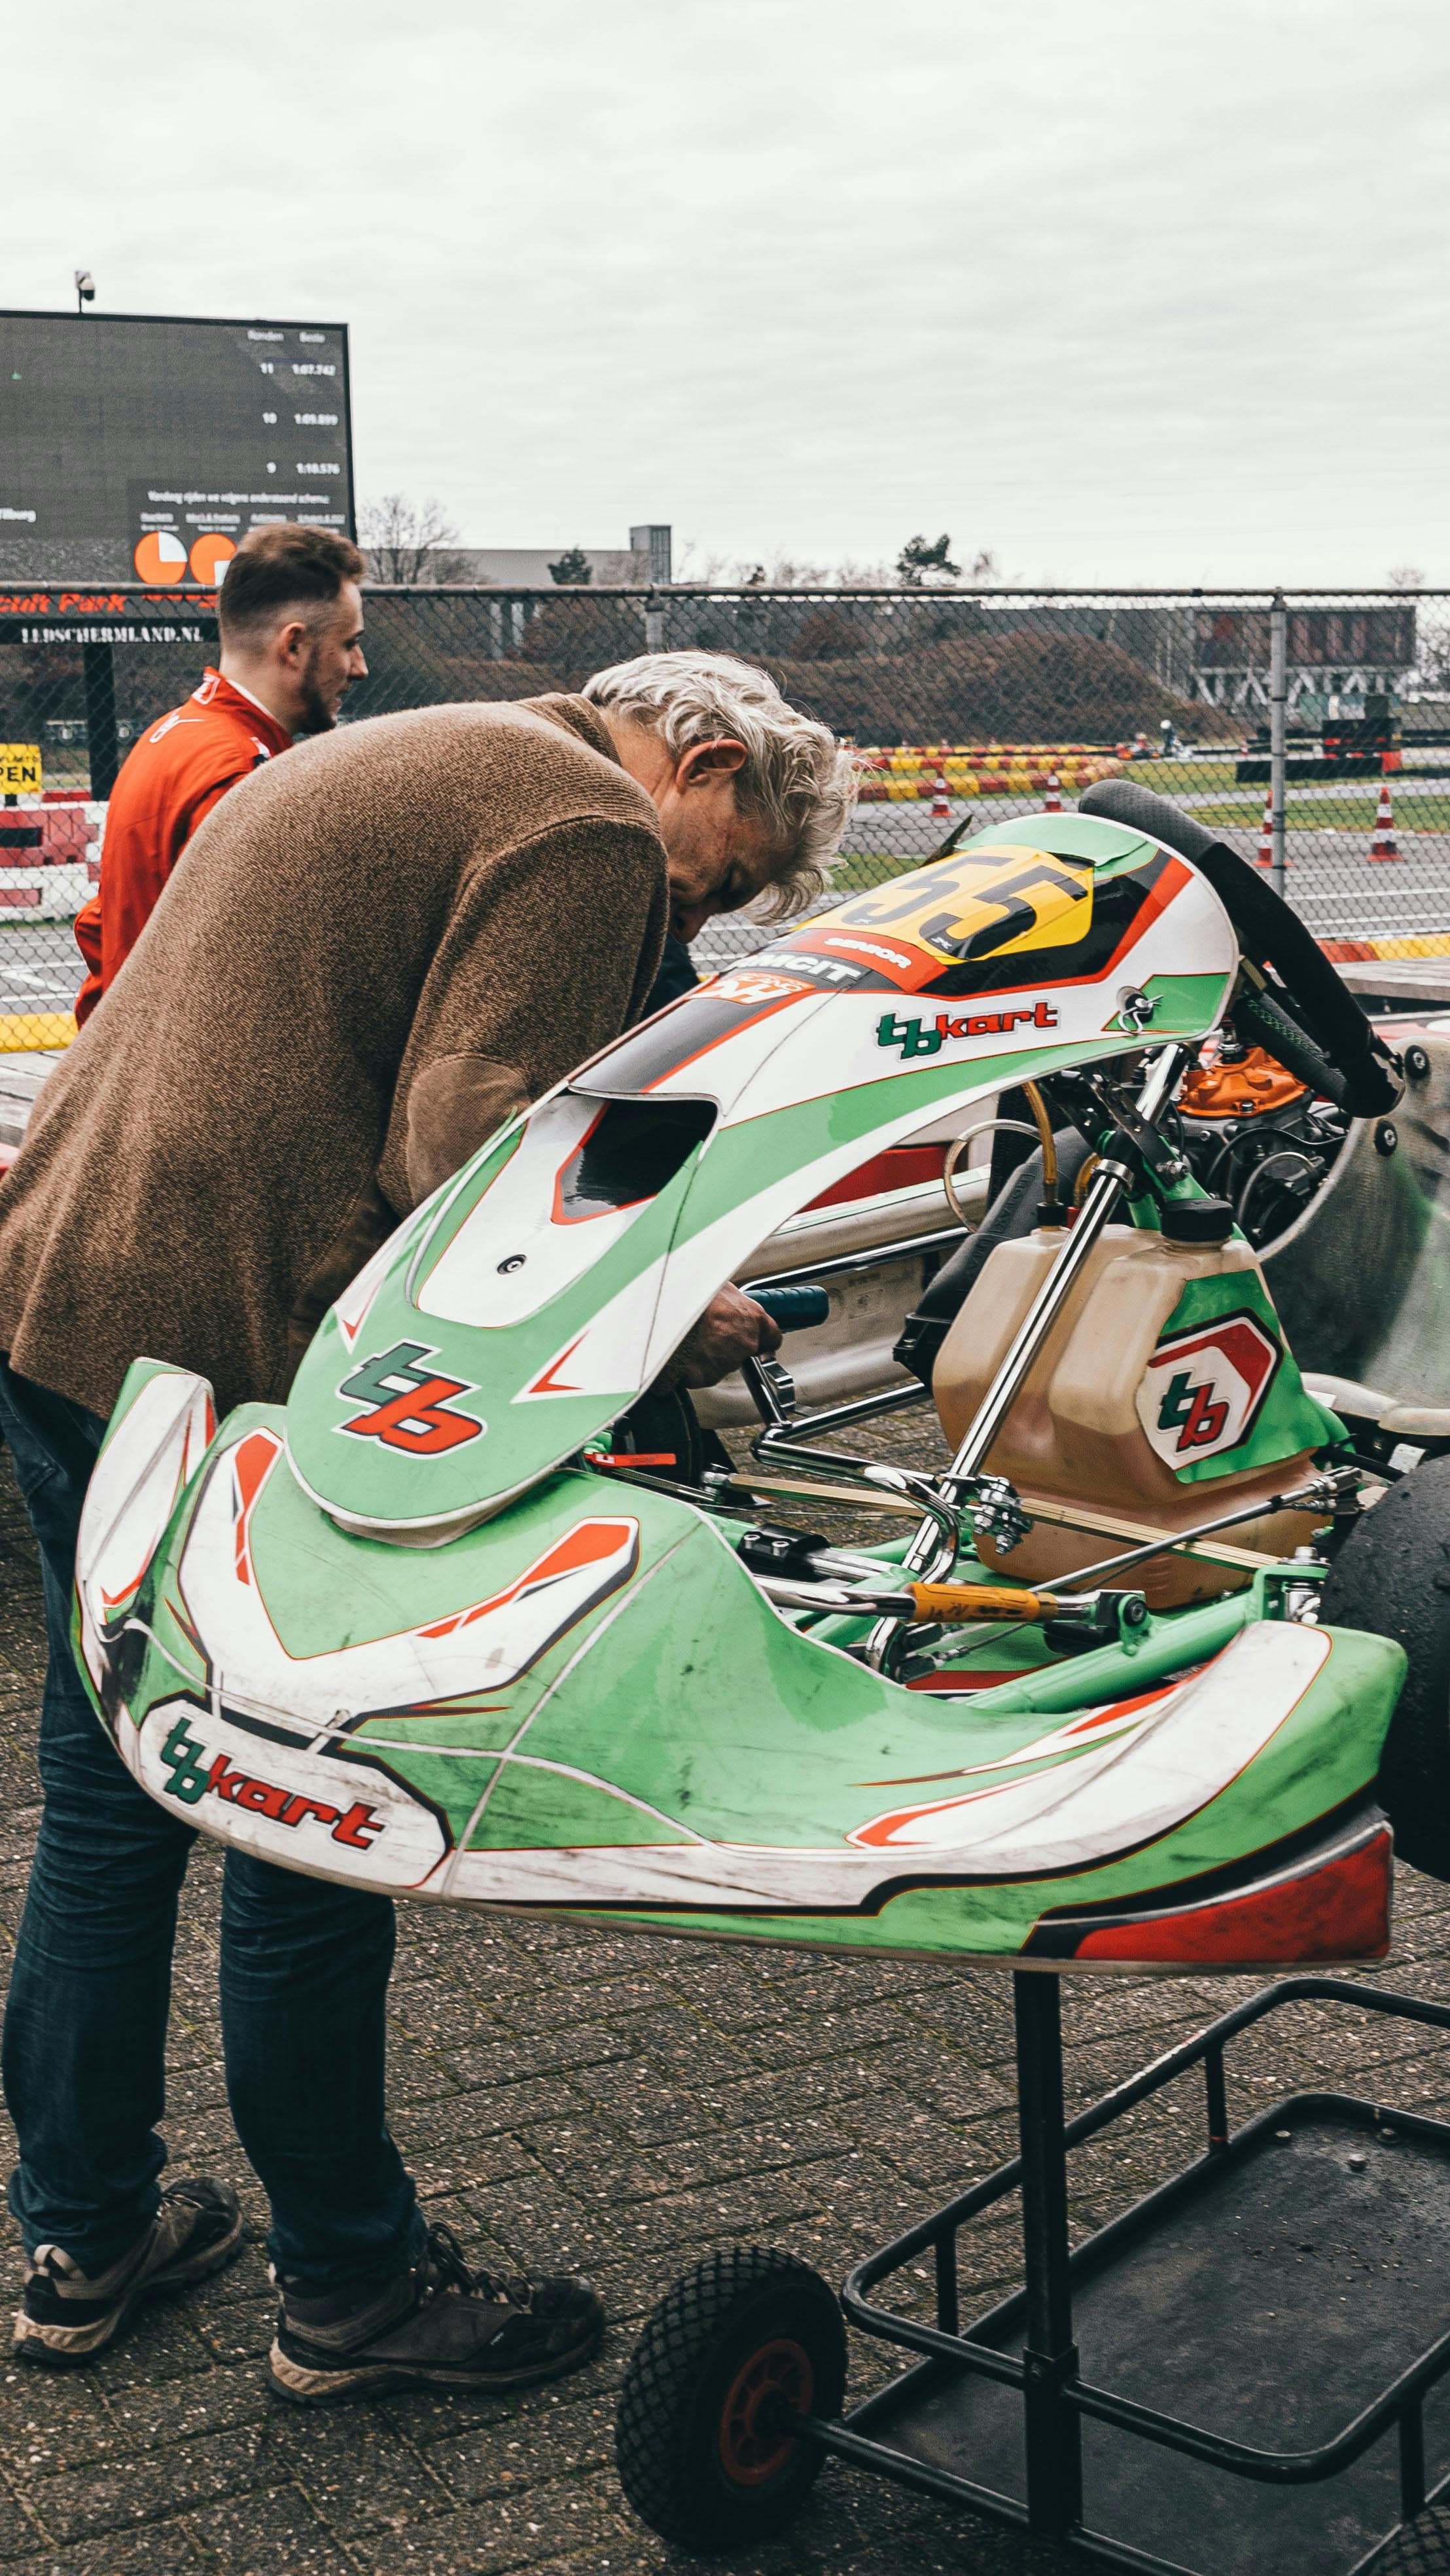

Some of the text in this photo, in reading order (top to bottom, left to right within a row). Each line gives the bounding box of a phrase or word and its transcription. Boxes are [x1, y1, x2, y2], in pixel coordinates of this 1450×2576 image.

[261, 363, 274, 374] 11
[58, 594, 127, 612] Park
[841, 855, 1088, 960] 55
[824, 937, 911, 969] SENIOR
